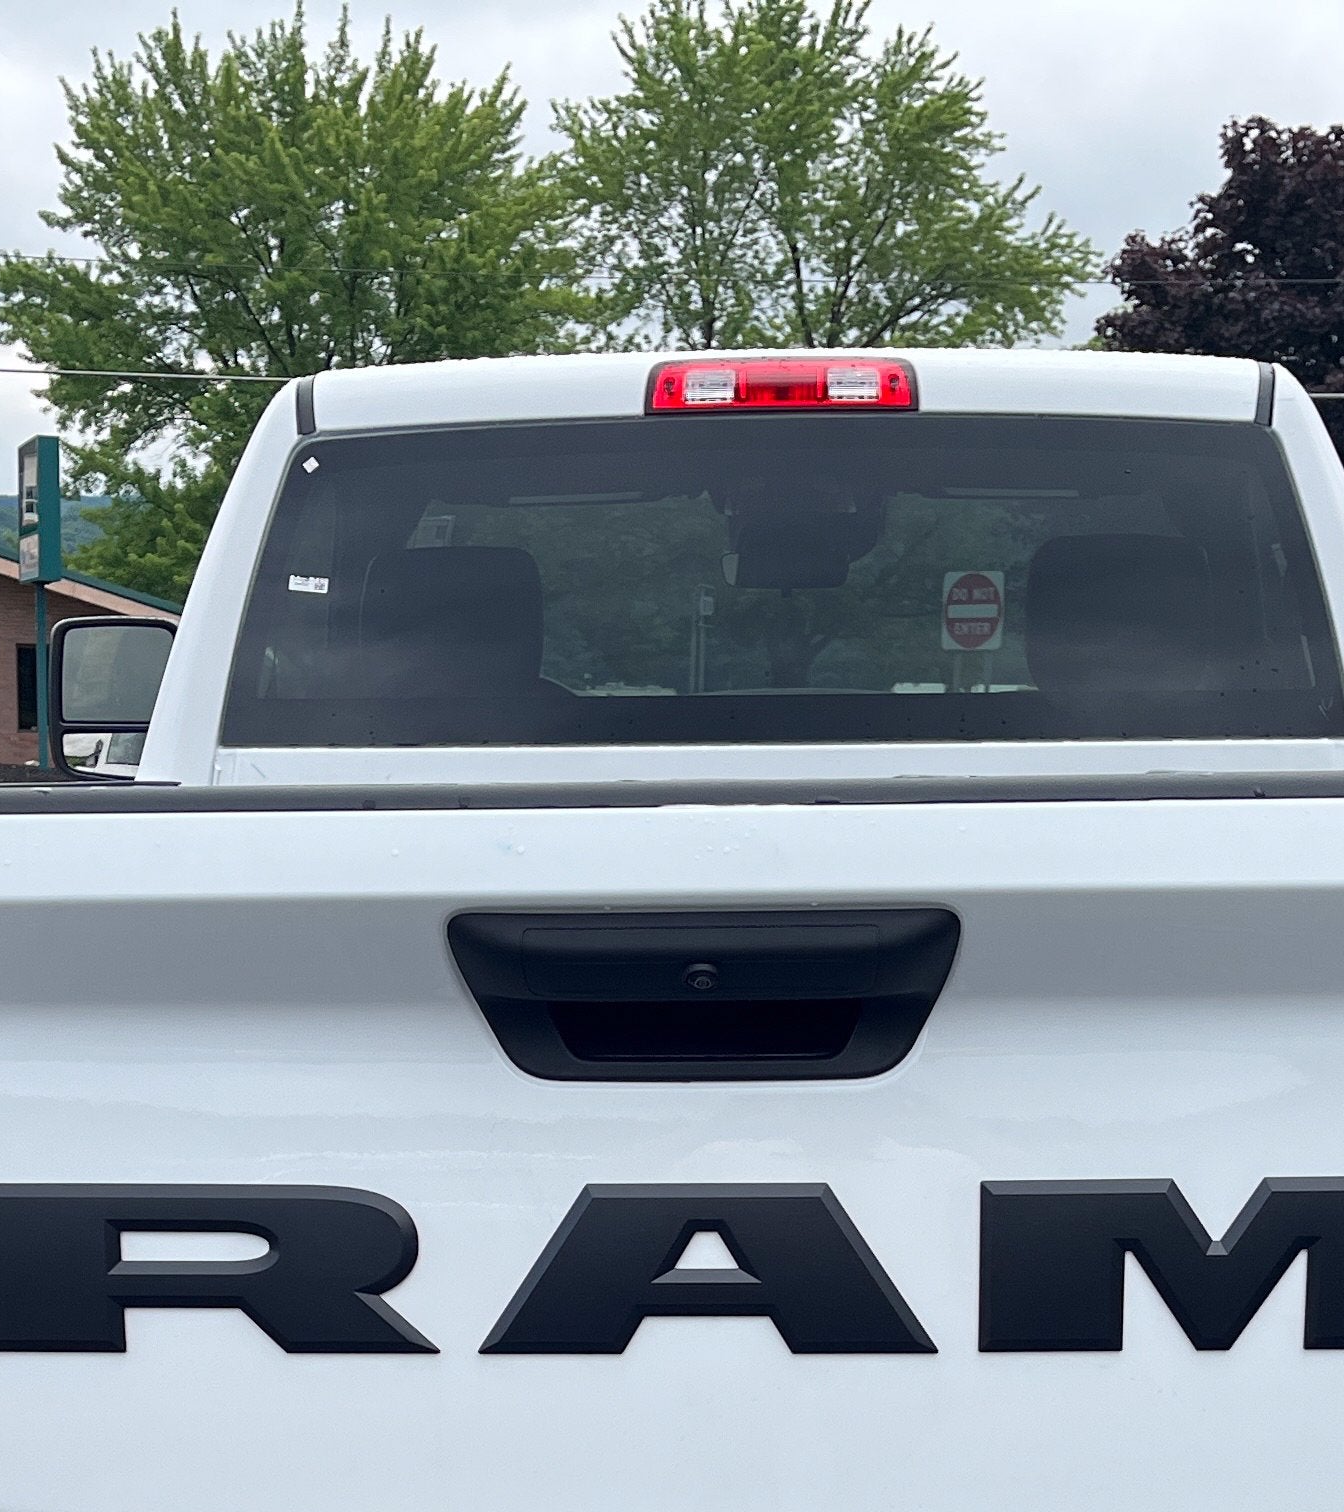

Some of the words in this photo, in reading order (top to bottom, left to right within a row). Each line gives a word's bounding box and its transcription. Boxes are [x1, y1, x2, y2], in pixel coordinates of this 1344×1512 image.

[952, 587, 968, 601] DO
[973, 587, 995, 600] NOT
[954, 622, 992, 636] ENTER
